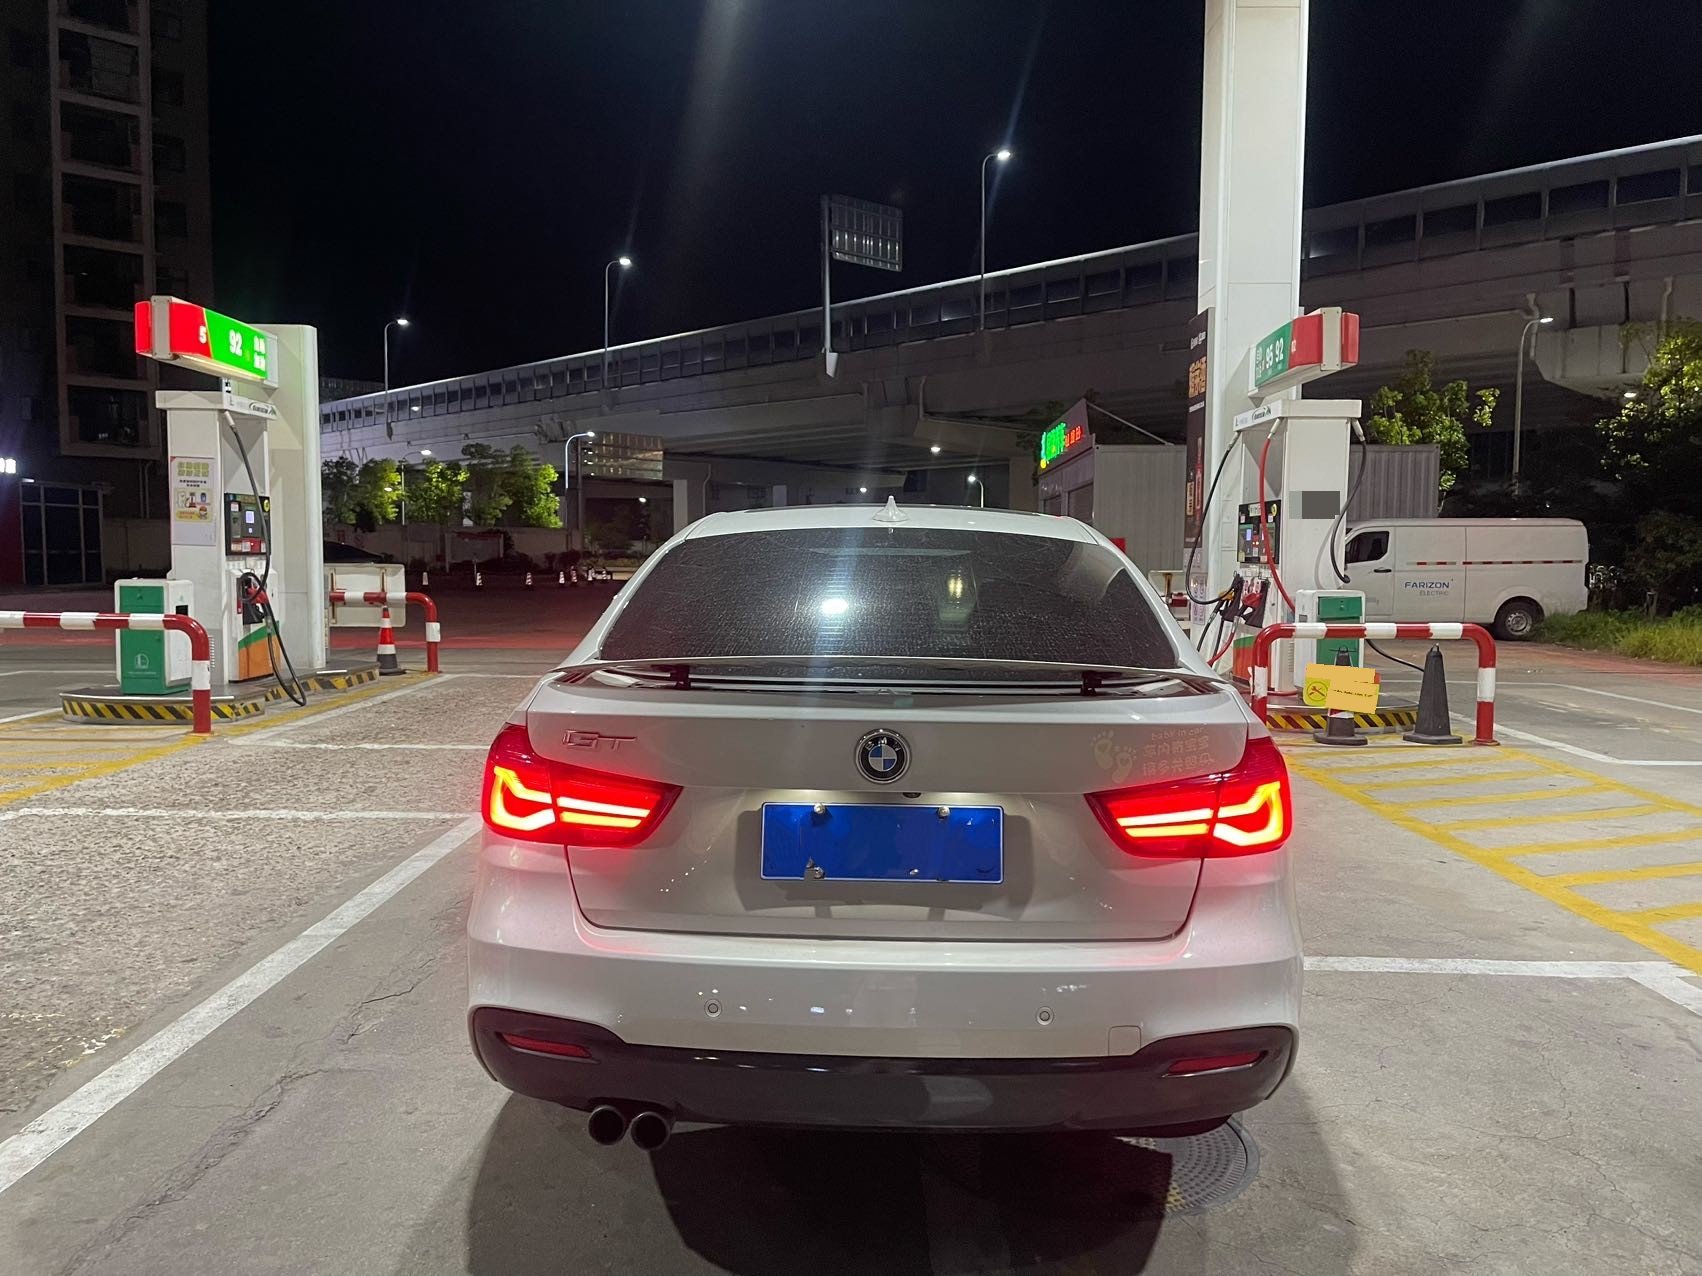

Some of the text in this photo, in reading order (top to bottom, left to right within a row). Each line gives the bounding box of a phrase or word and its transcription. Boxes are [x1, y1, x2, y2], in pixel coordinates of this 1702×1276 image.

[229, 329, 243, 357] 92
[1275, 337, 1284, 363] 92
[1404, 581, 1450, 589] FARIZON
[562, 729, 637, 751] GT
